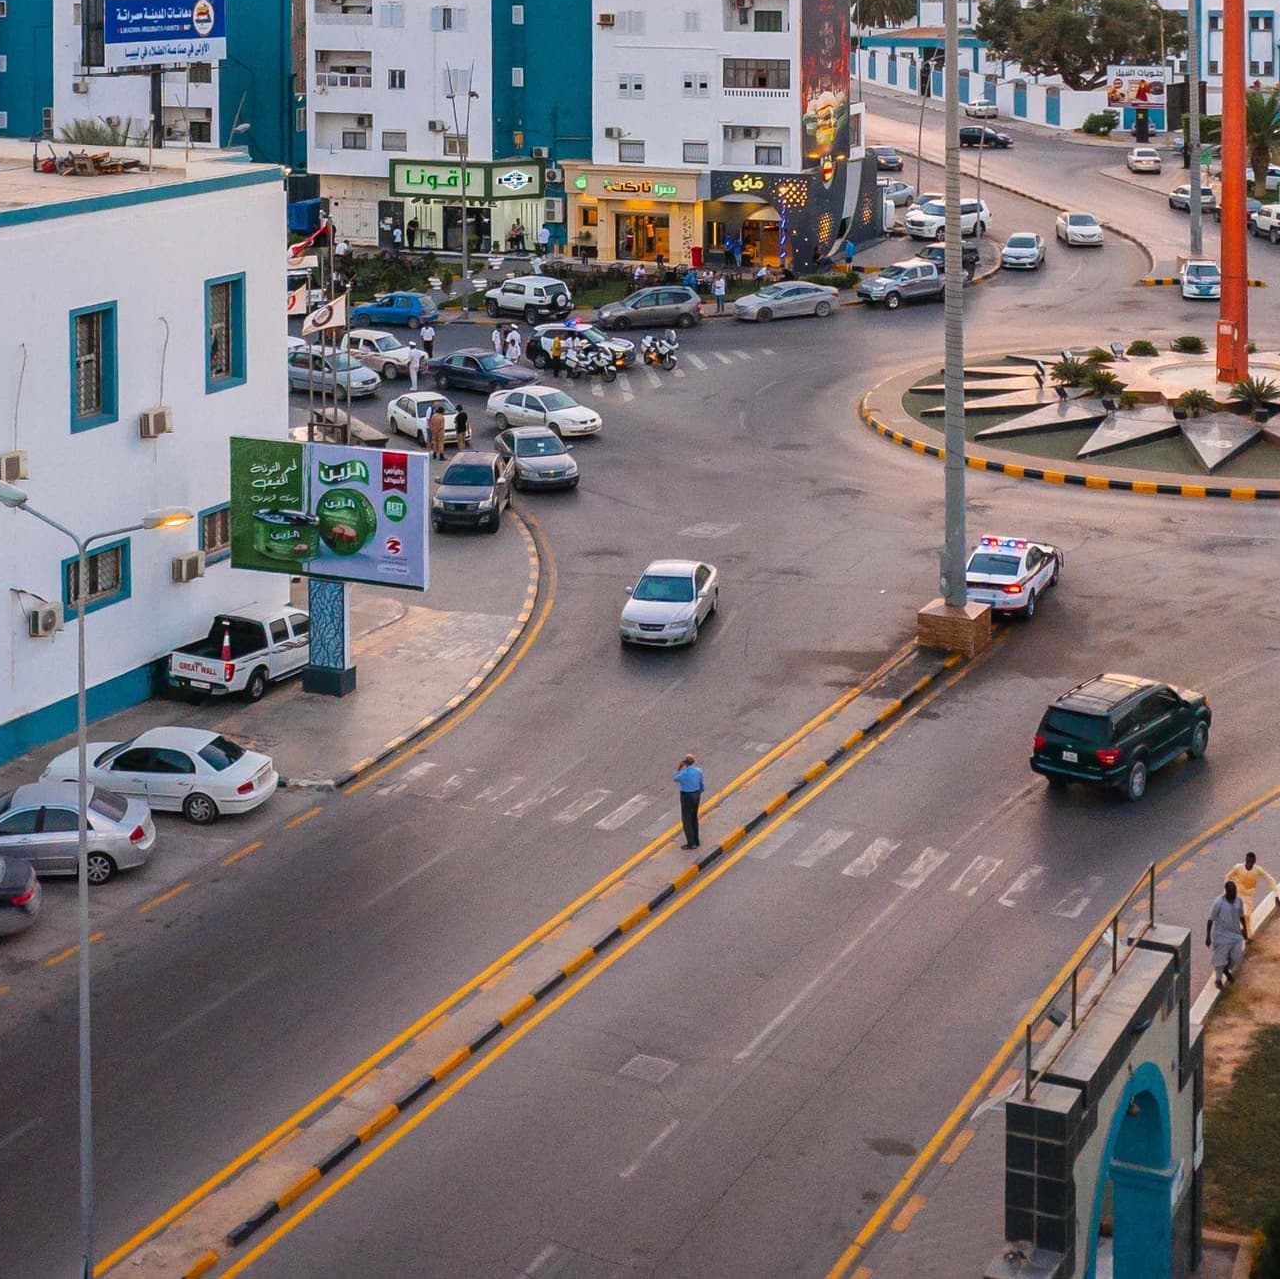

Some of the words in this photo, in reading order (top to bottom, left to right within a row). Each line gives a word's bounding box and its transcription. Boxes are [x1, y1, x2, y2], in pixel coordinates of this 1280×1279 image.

[320, 463, 366, 482] الزين
[178, 662, 199, 673] GREAT
[200, 665, 217, 676] WALL
